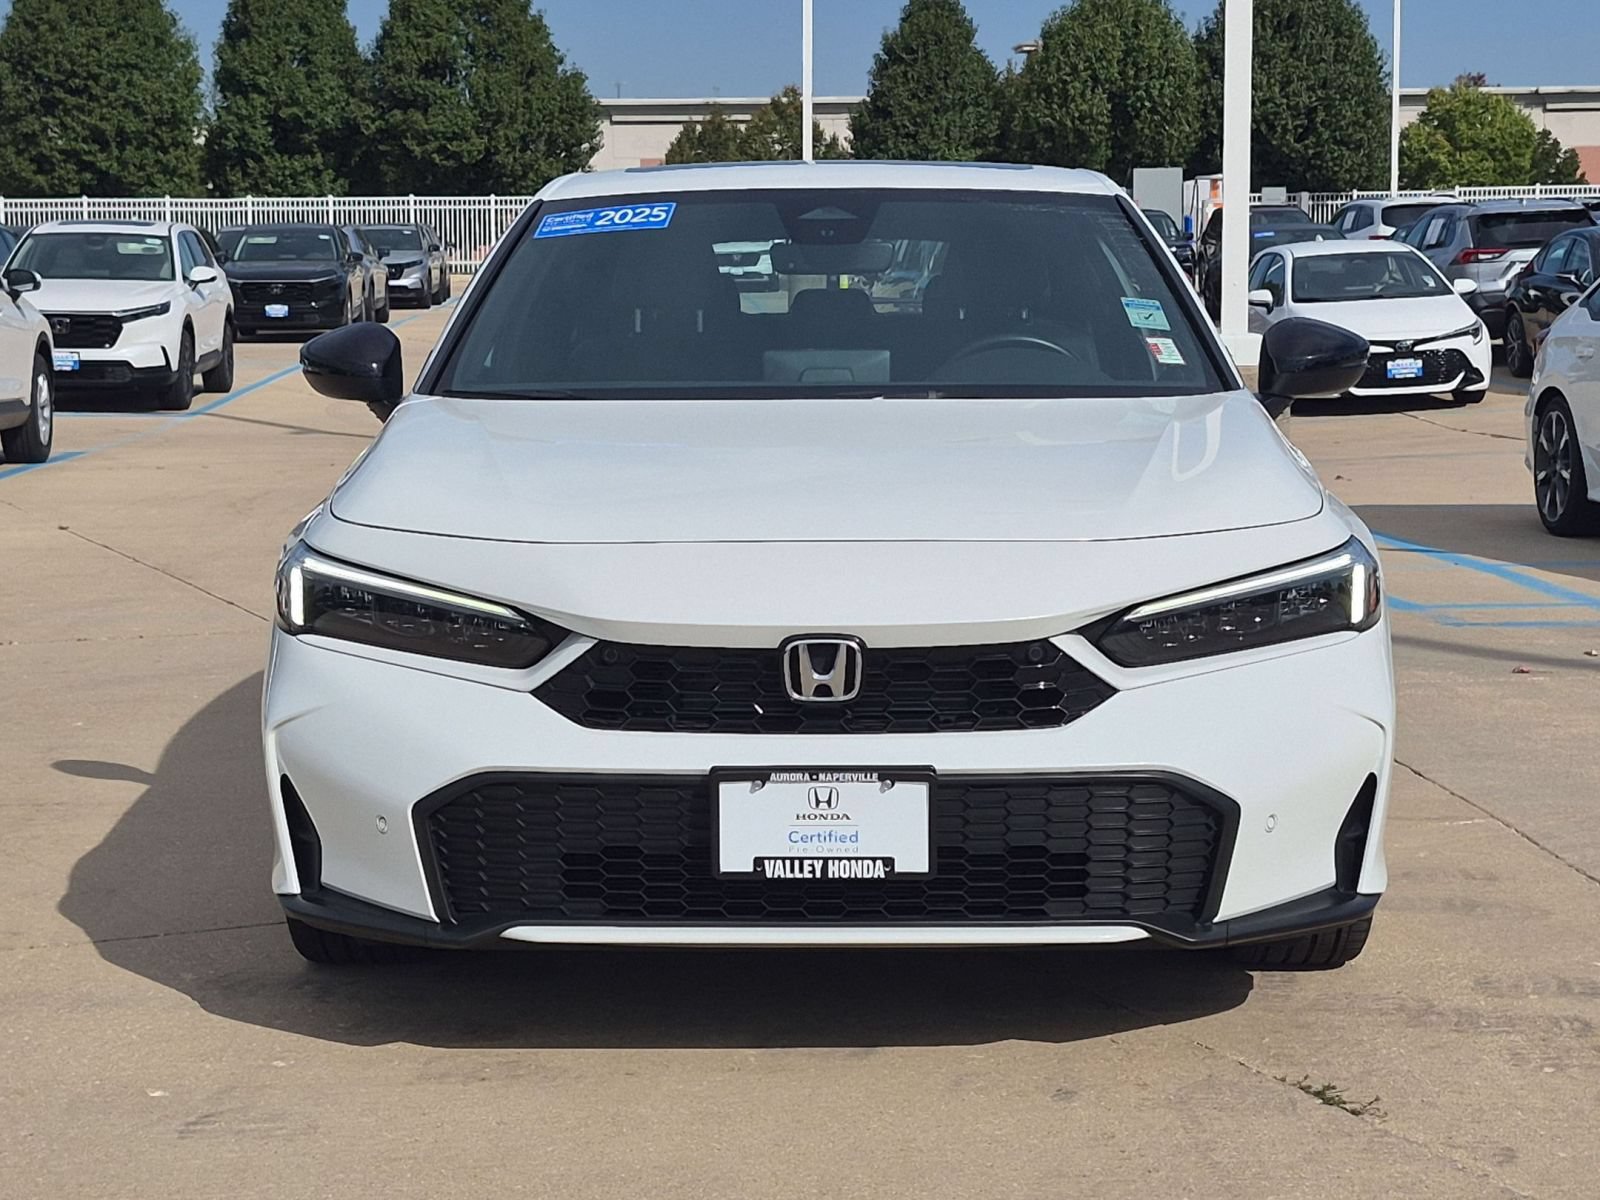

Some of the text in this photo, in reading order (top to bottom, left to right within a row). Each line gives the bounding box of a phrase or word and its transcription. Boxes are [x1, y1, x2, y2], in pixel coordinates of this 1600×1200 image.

[594, 206, 669, 225] 2025
[769, 772, 879, 782] AURORA NAPERVILLE
[788, 830, 859, 844] Certified
[815, 845, 859, 853] Owned
[764, 859, 886, 879] VALLEY HONDA
